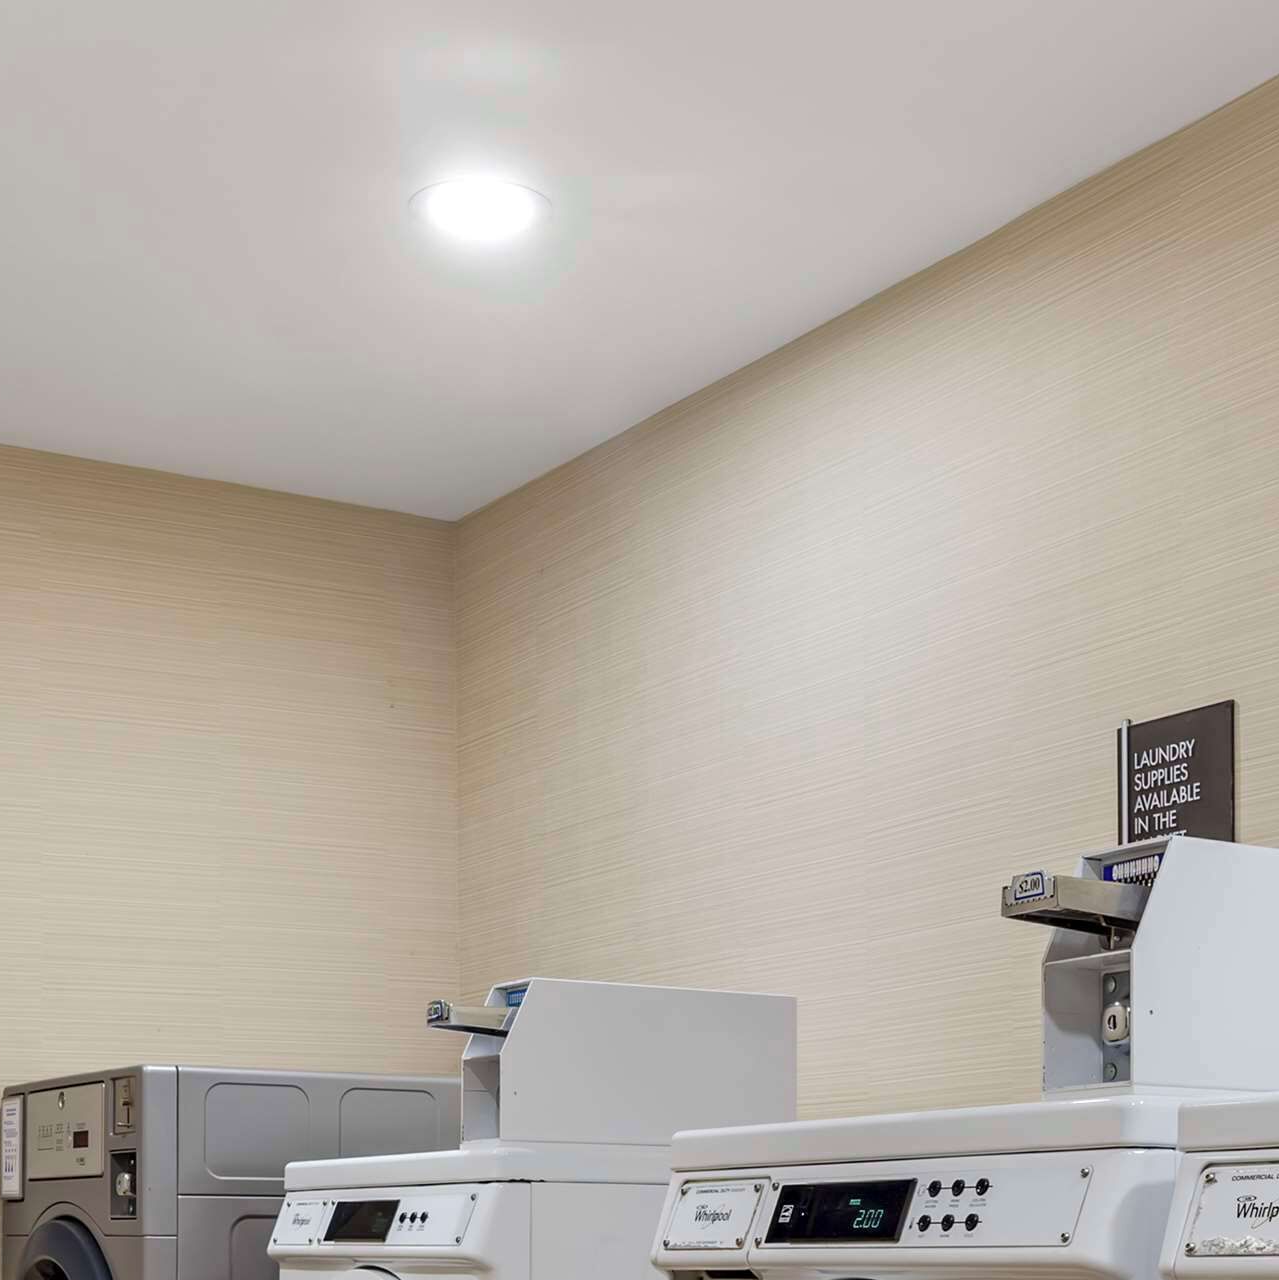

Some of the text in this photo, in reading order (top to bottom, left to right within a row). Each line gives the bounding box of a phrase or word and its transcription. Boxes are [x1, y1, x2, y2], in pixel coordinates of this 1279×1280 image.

[1134, 738, 1196, 770] LAUNDRY
[1134, 763, 1189, 791] SUPPLIES
[1134, 782, 1201, 813] AVAILABLE
[1134, 809, 1177, 835] IN THE
[1231, 1173, 1274, 1181] COMMERCIAL
[852, 1209, 884, 1229] 2.00
